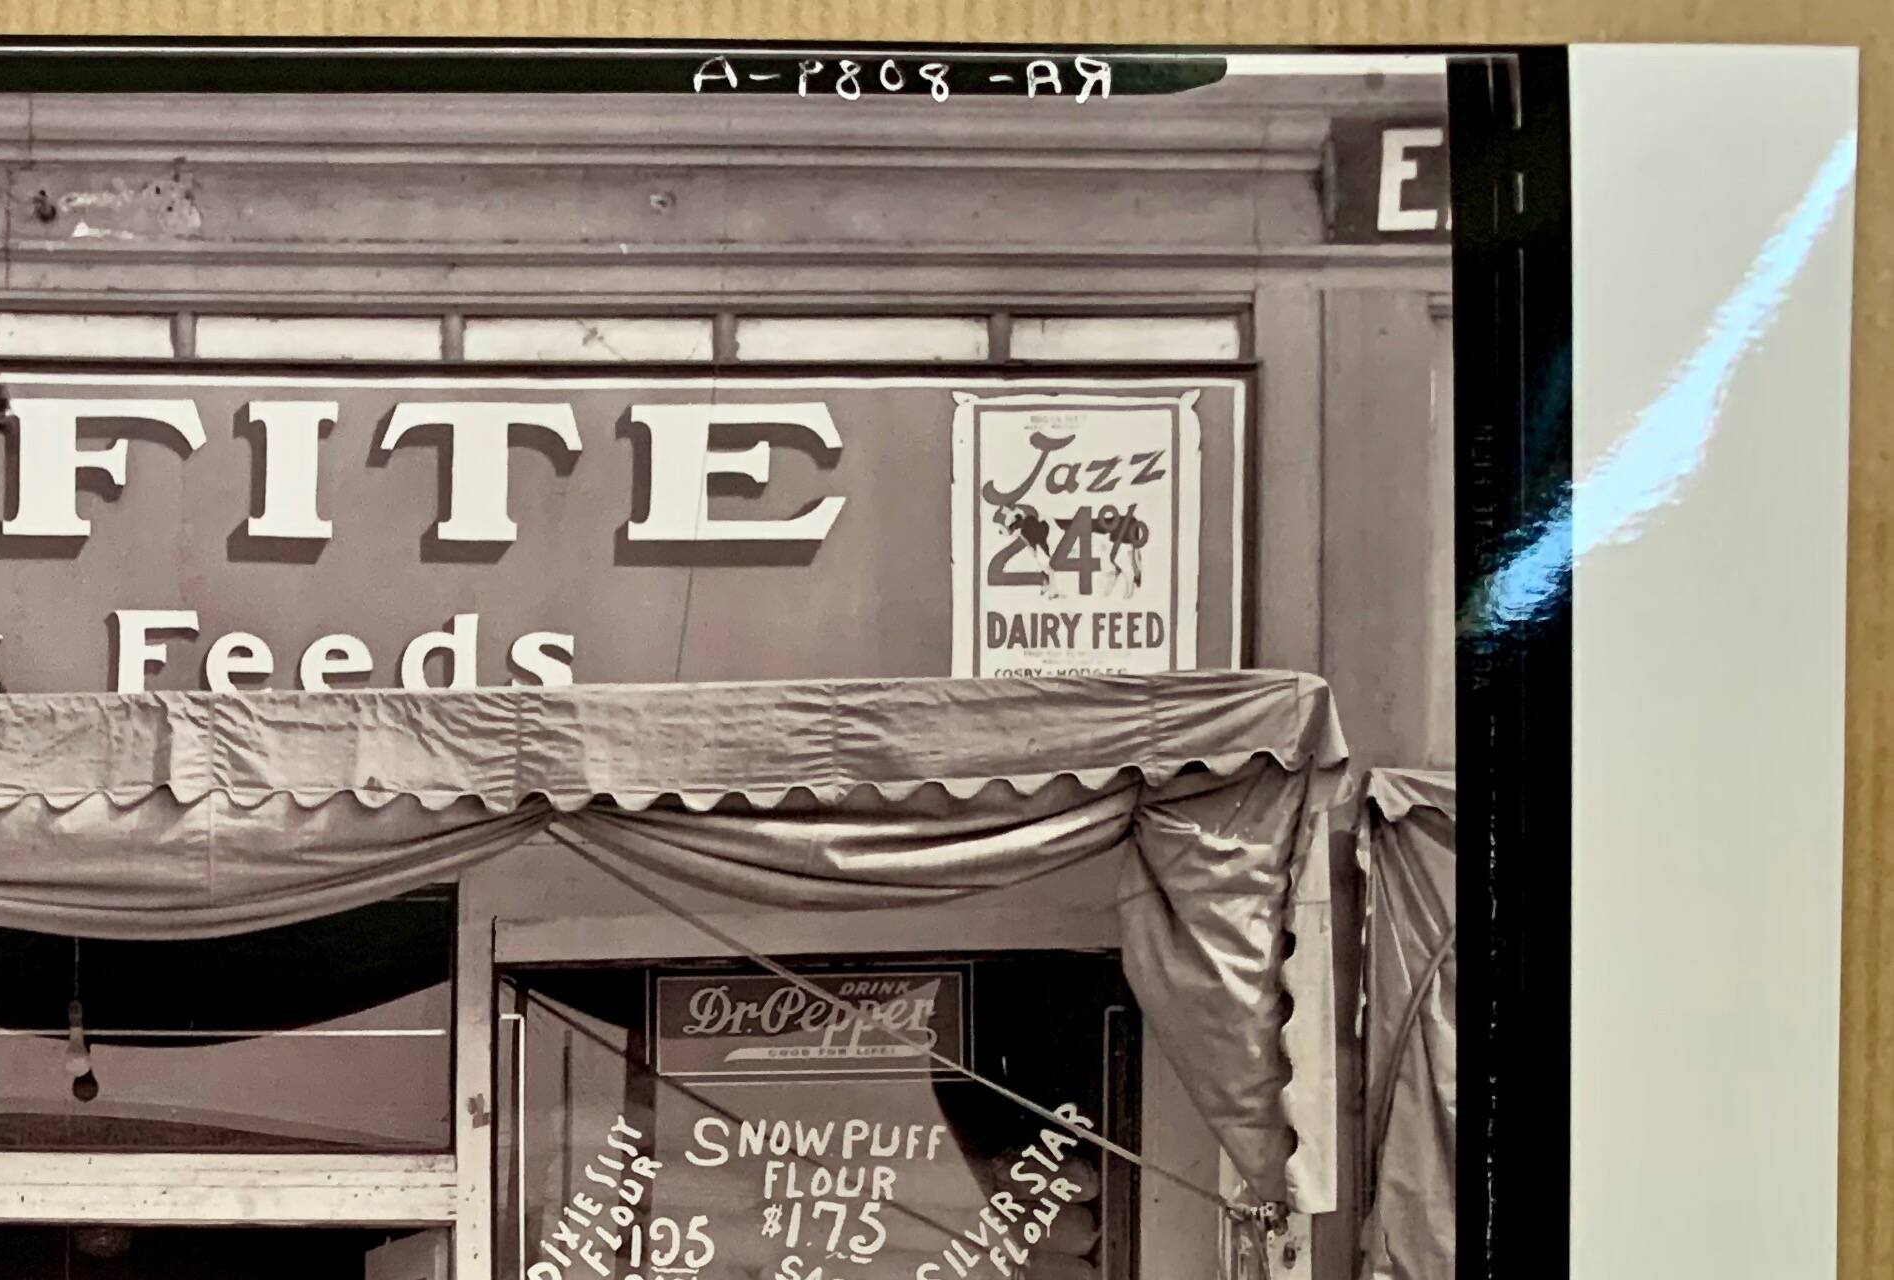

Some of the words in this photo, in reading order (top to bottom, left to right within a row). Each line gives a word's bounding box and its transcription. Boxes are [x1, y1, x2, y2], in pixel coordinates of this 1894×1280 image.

[1377, 127, 1452, 232] E
[1, 399, 847, 542] FITE
[982, 431, 1166, 506] Jazz
[987, 503, 1149, 595] 24%
[110, 610, 574, 694] Feeds
[987, 611, 1082, 650] DAIRY
[1091, 611, 1164, 650] FEED
[840, 982, 909, 997] DRINK
[684, 1118, 834, 1166] SNOW
[842, 1119, 946, 1160] PUFF
[763, 1160, 897, 1200] FLOUR
[1010, 1102, 1094, 1195] STAR
[579, 1155, 663, 1277] FLOUR
[761, 1201, 886, 1255] $1.75
[990, 1177, 1082, 1277] FLOUR
